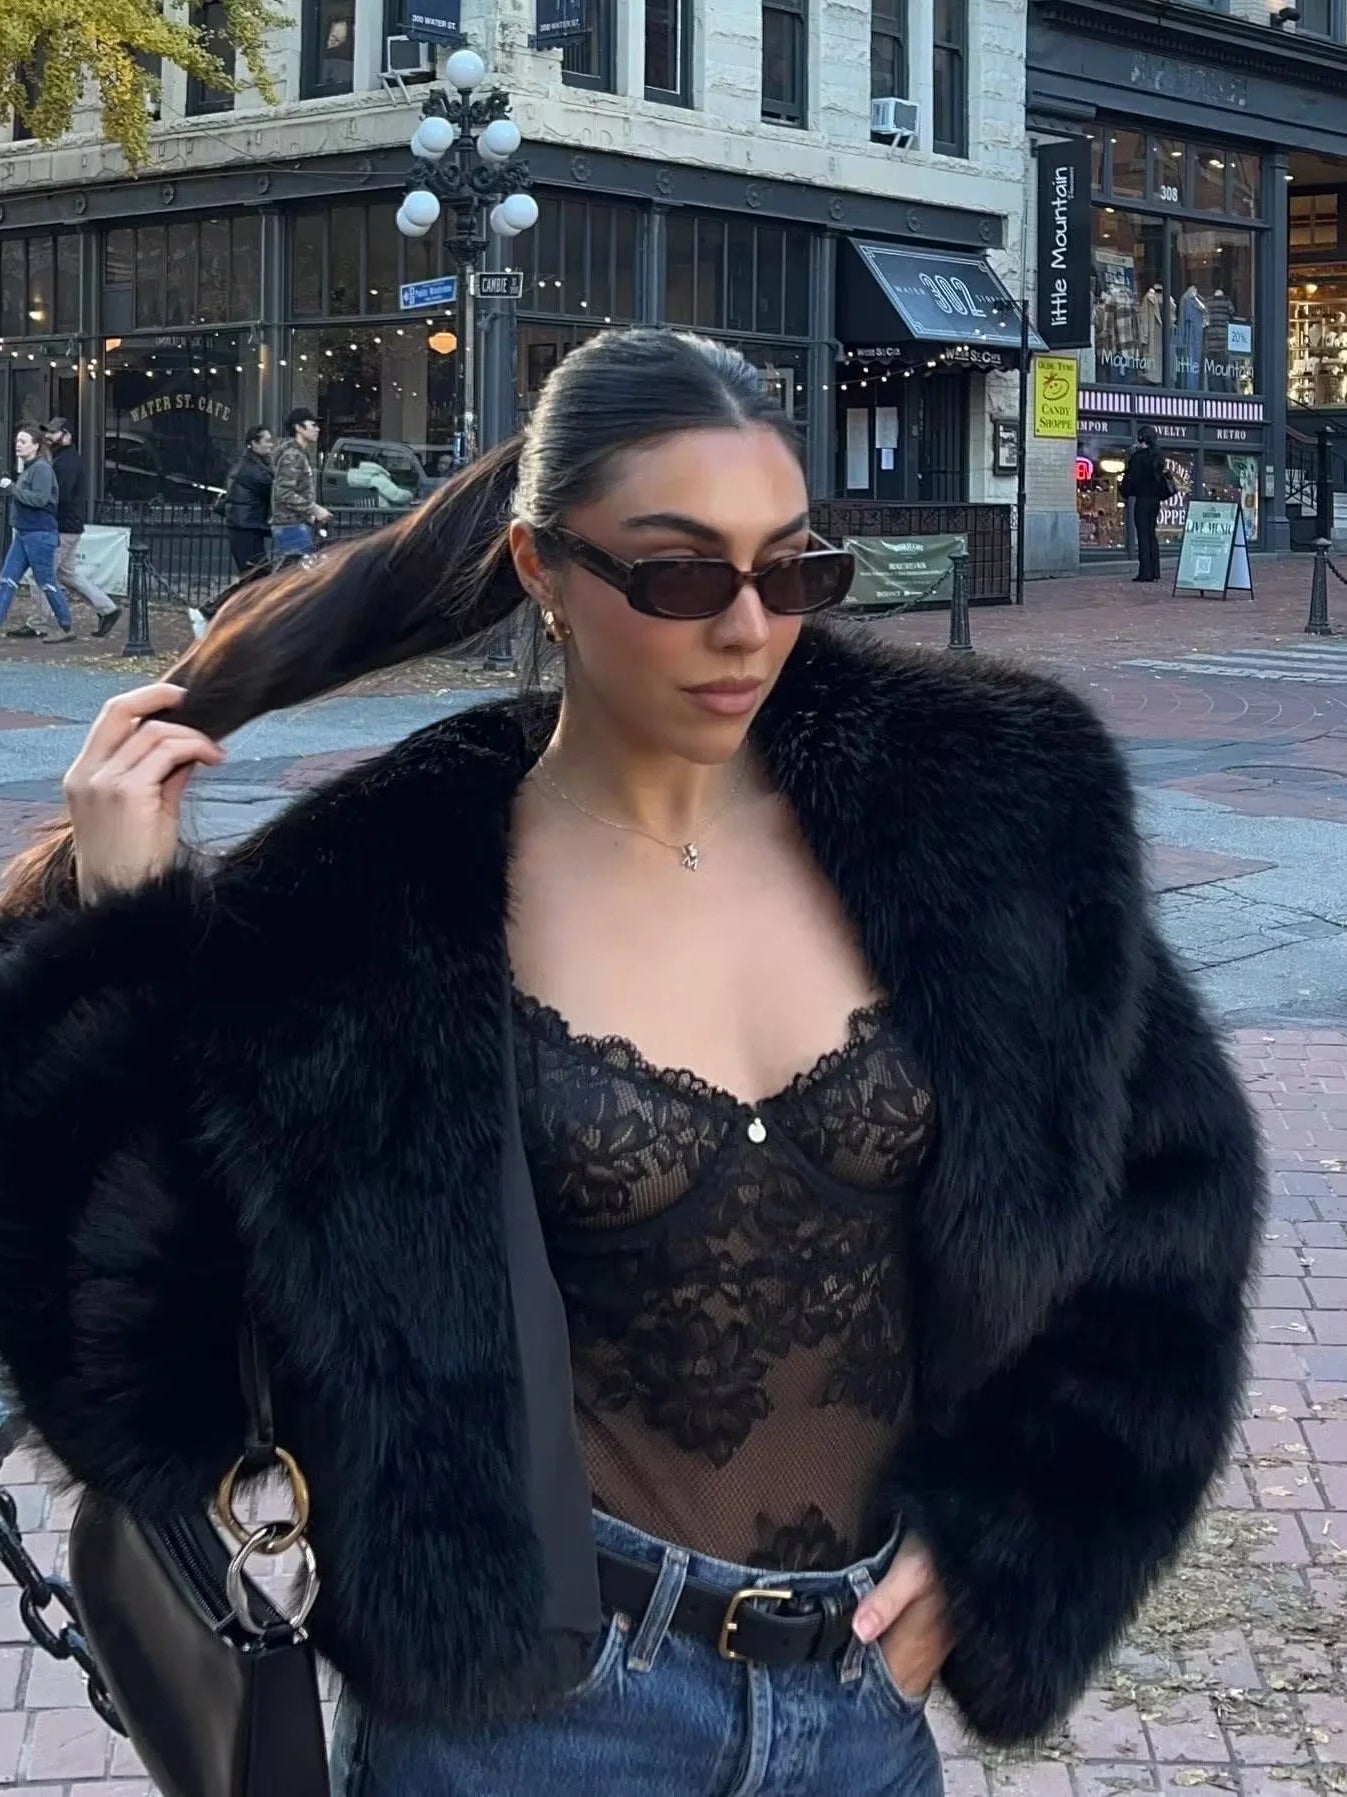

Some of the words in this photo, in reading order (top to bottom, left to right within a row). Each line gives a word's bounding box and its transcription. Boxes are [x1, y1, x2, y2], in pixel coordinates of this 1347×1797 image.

[424, 16, 447, 29] WATER
[1160, 184, 1178, 202] 308
[1051, 166, 1068, 269] Mountain
[481, 277, 508, 294] CAMBIE
[918, 271, 987, 318] 302
[1051, 278, 1067, 326] little
[1057, 361, 1074, 372] TYME
[130, 396, 172, 423] WATER
[175, 394, 195, 409] ST.
[198, 396, 232, 421] CAFE
[1041, 402, 1071, 417] CANDY
[1039, 416, 1073, 430] SHOPPE
[1216, 429, 1247, 441] RETRO
